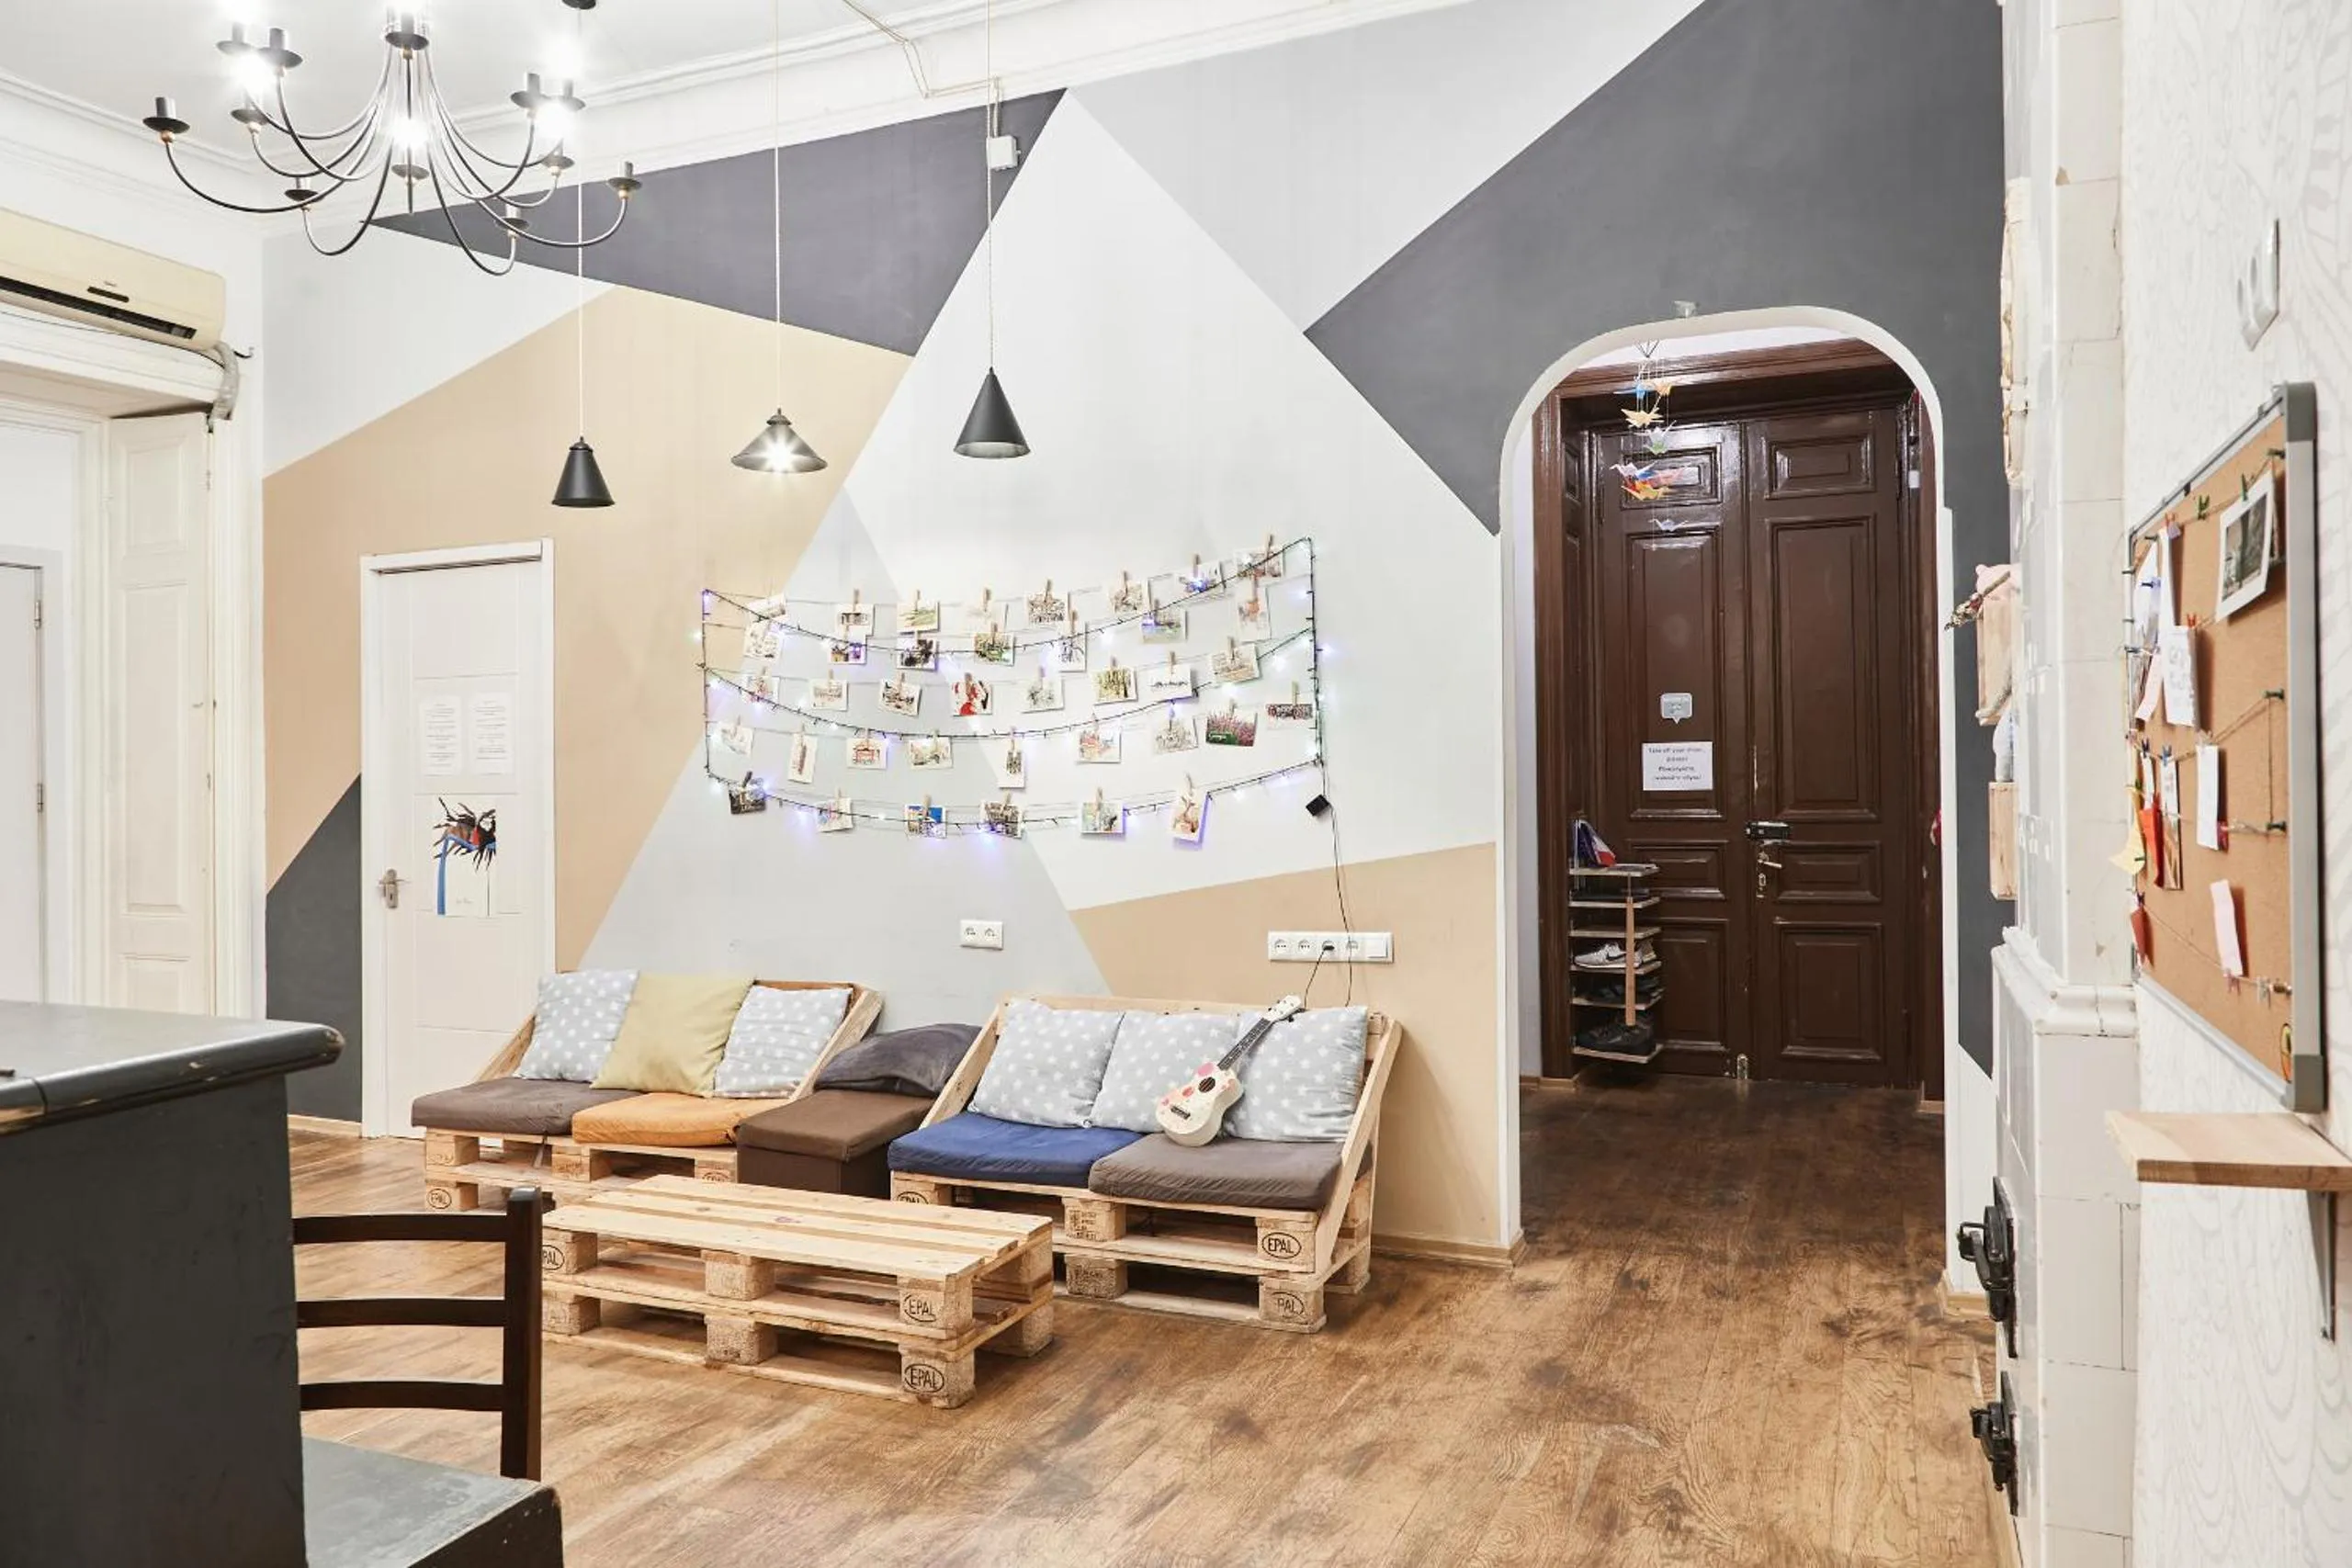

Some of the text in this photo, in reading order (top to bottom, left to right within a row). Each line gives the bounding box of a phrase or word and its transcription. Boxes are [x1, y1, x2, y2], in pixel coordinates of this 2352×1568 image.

[1268, 1237, 1294, 1253] EPAL
[909, 1299, 935, 1316] EPAL
[910, 1368, 936, 1388] EPAL
